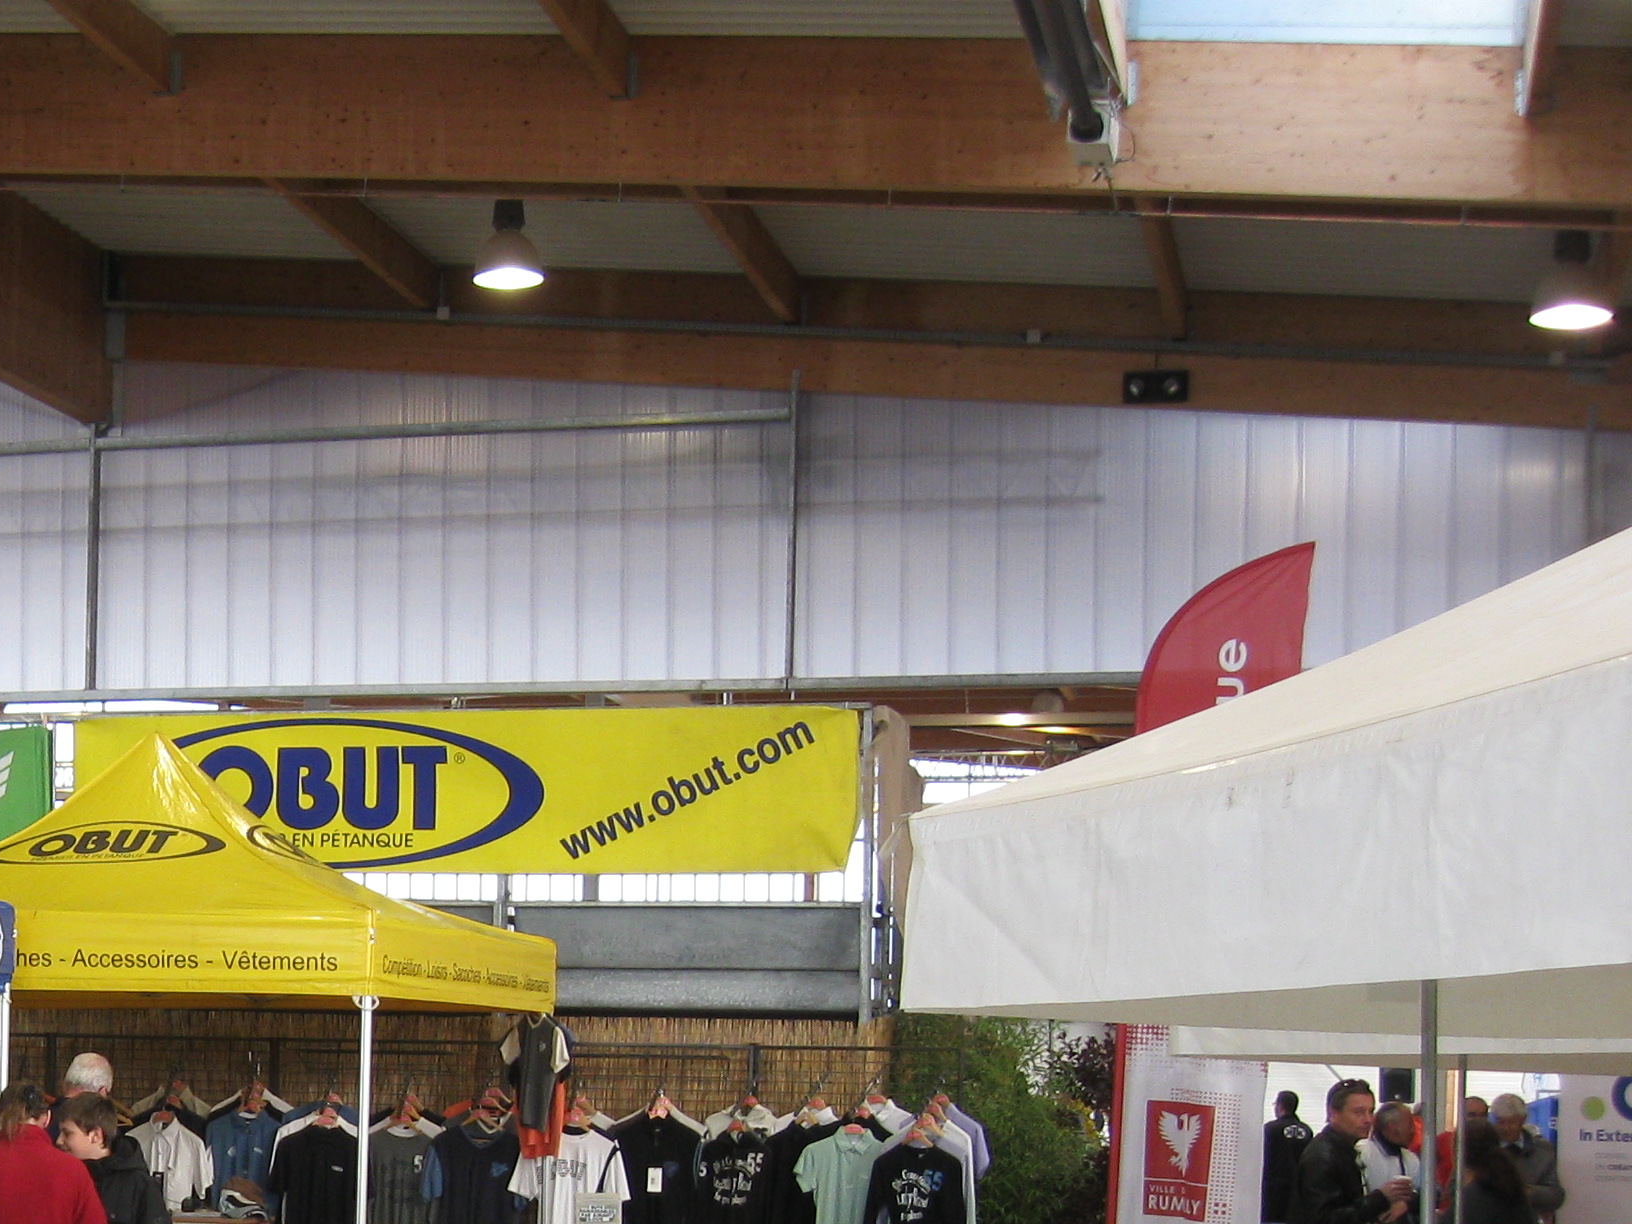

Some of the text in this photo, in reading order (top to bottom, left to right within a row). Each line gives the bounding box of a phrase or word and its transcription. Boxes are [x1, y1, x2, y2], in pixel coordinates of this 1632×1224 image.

[198, 744, 448, 831] OBUT
[559, 721, 816, 861] www.obut.com
[28, 829, 182, 857] OBUT
[293, 833, 315, 848] EN
[319, 829, 414, 849] PÉTANQUE
[72, 949, 199, 969] Accessoires
[222, 949, 338, 972] Vêtements
[1579, 1129, 1592, 1141] In
